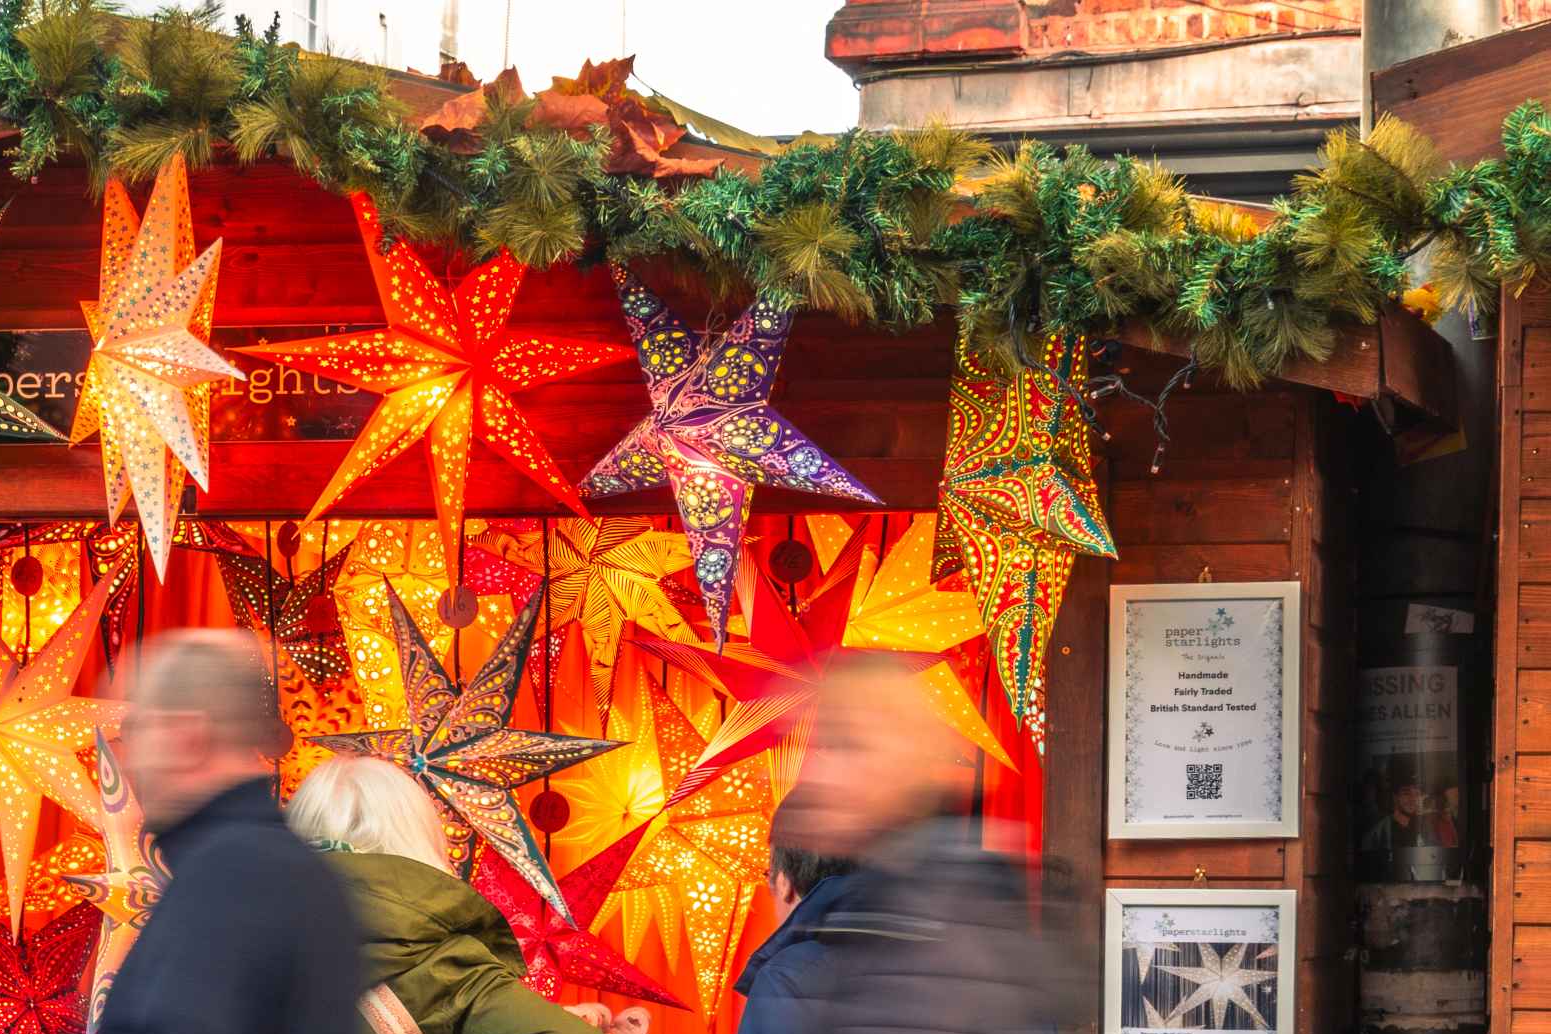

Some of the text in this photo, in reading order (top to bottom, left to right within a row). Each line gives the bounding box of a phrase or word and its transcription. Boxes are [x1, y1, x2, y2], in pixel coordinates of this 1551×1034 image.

[1164, 627, 1203, 638] paper
[1164, 637, 1241, 648] starlights
[1177, 671, 1229, 680] Handmade
[1173, 687, 1234, 697] Fairly Traded
[1149, 702, 1258, 713] British Standard Tested
[1162, 928, 1247, 938] paperstarlights
